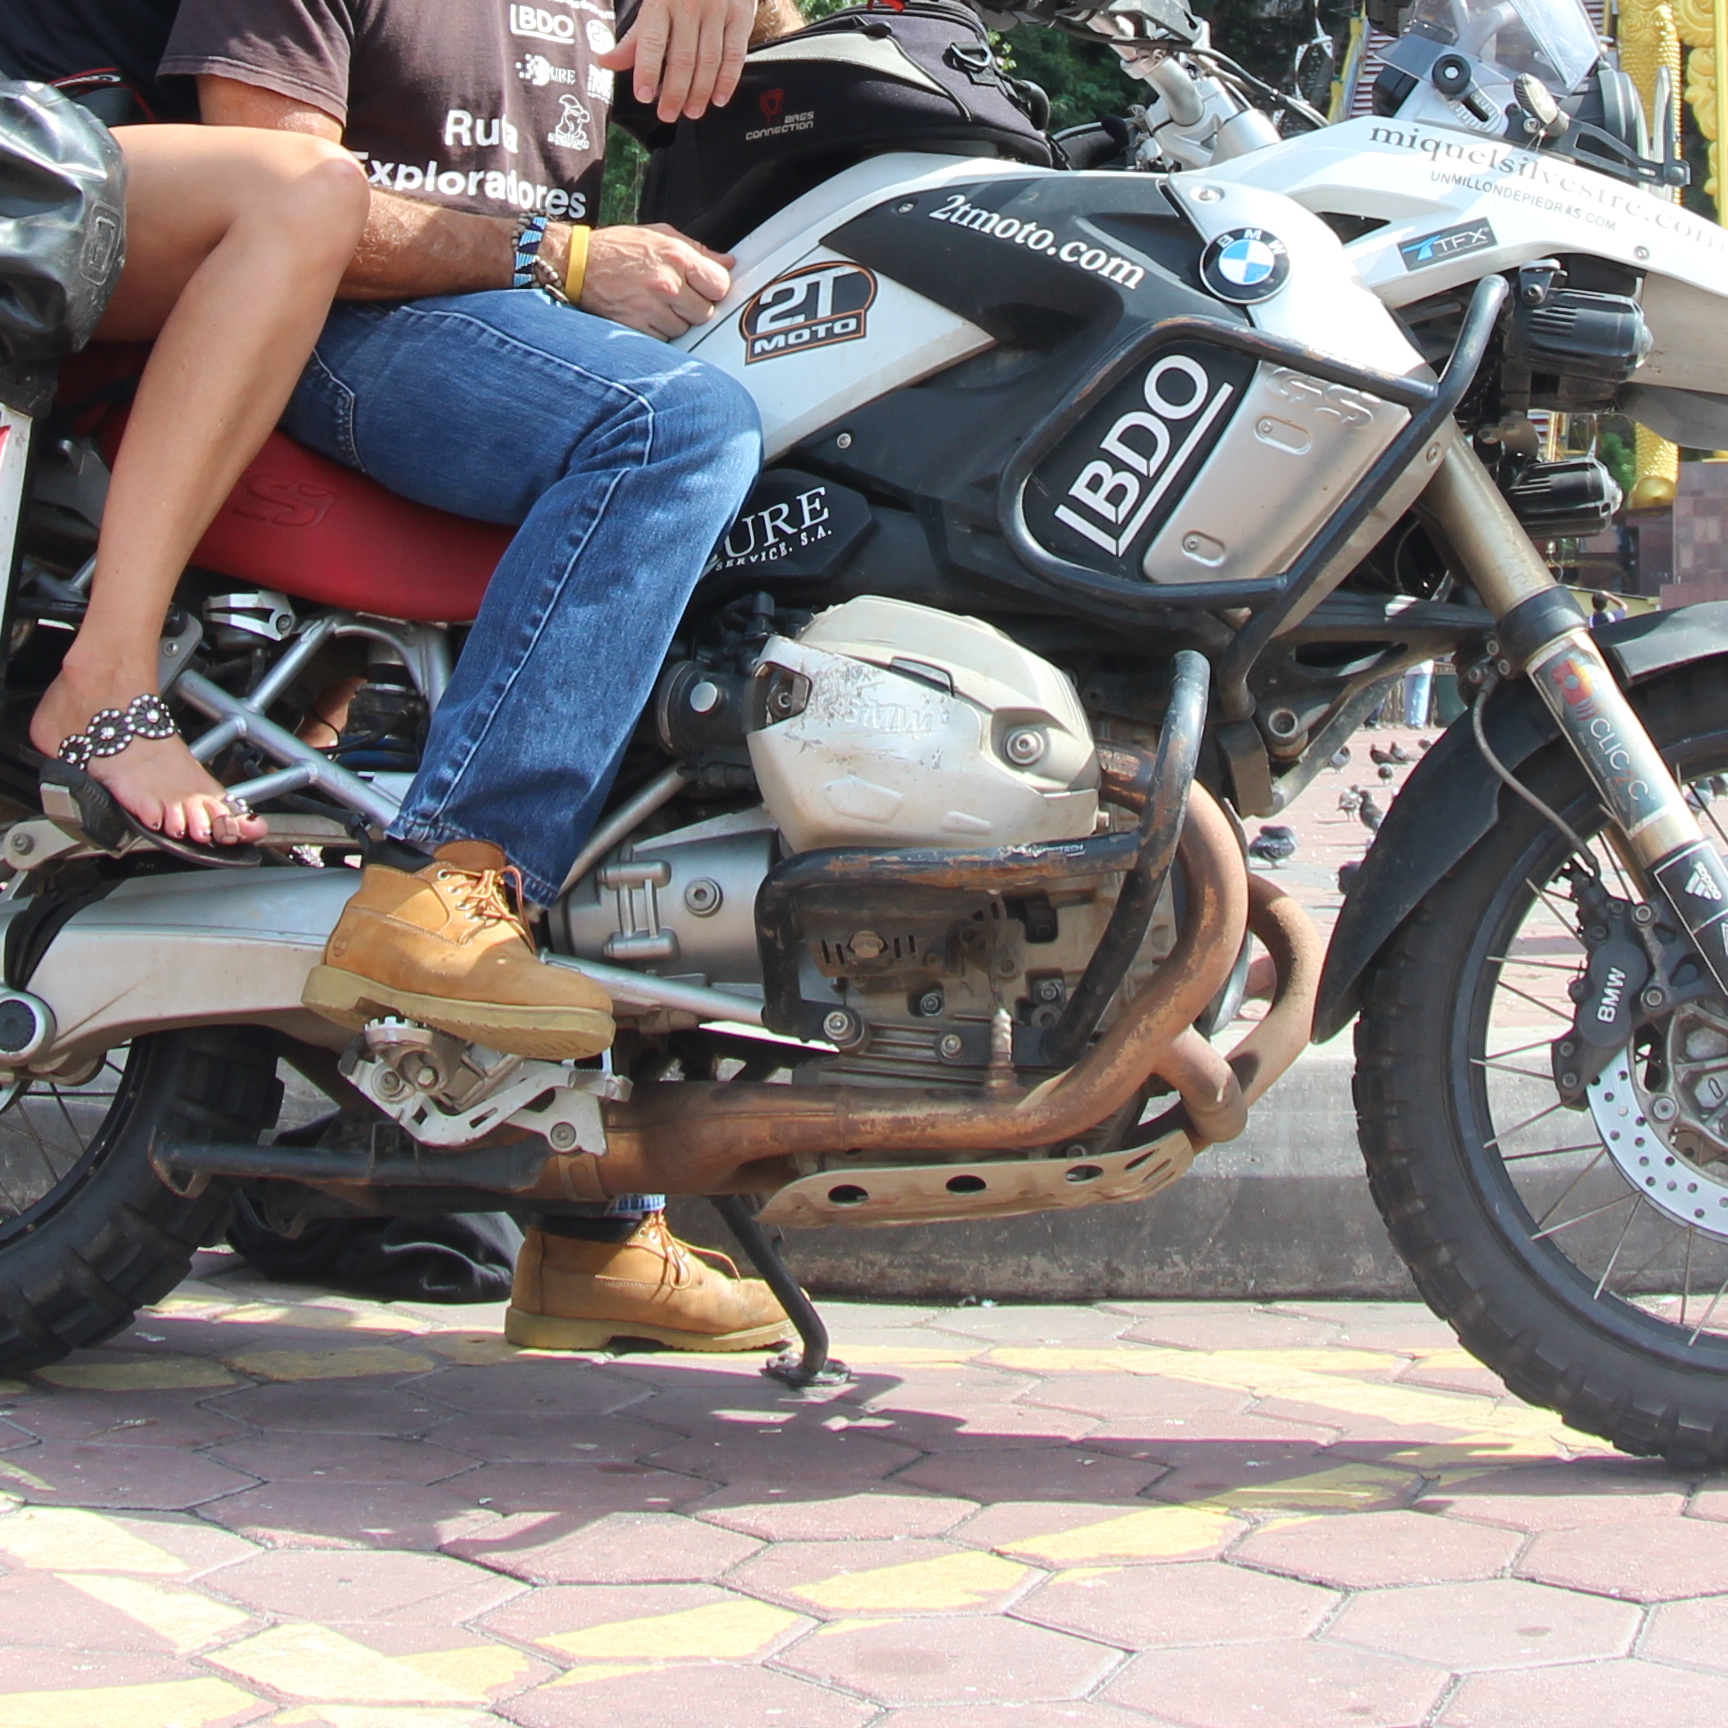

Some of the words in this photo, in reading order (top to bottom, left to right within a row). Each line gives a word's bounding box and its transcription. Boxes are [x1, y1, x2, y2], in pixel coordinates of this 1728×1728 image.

[519, 5, 575, 38] BDO
[745, 120, 815, 141] CONNECTION
[784, 110, 815, 125] BAGS
[1429, 170, 1616, 232] UNMILLONDEPIEDRAS.COM
[928, 193, 1147, 290] 2tmoto.com
[1215, 228, 1288, 257] BMW
[1433, 227, 1487, 252] TFX
[756, 264, 862, 335] 2T
[753, 317, 858, 355] MOTO
[1068, 354, 1212, 526] BDO
[800, 527, 833, 547] S.A.
[1590, 718, 1649, 802] CLIC2C
[1597, 966, 1626, 1024] BMW
